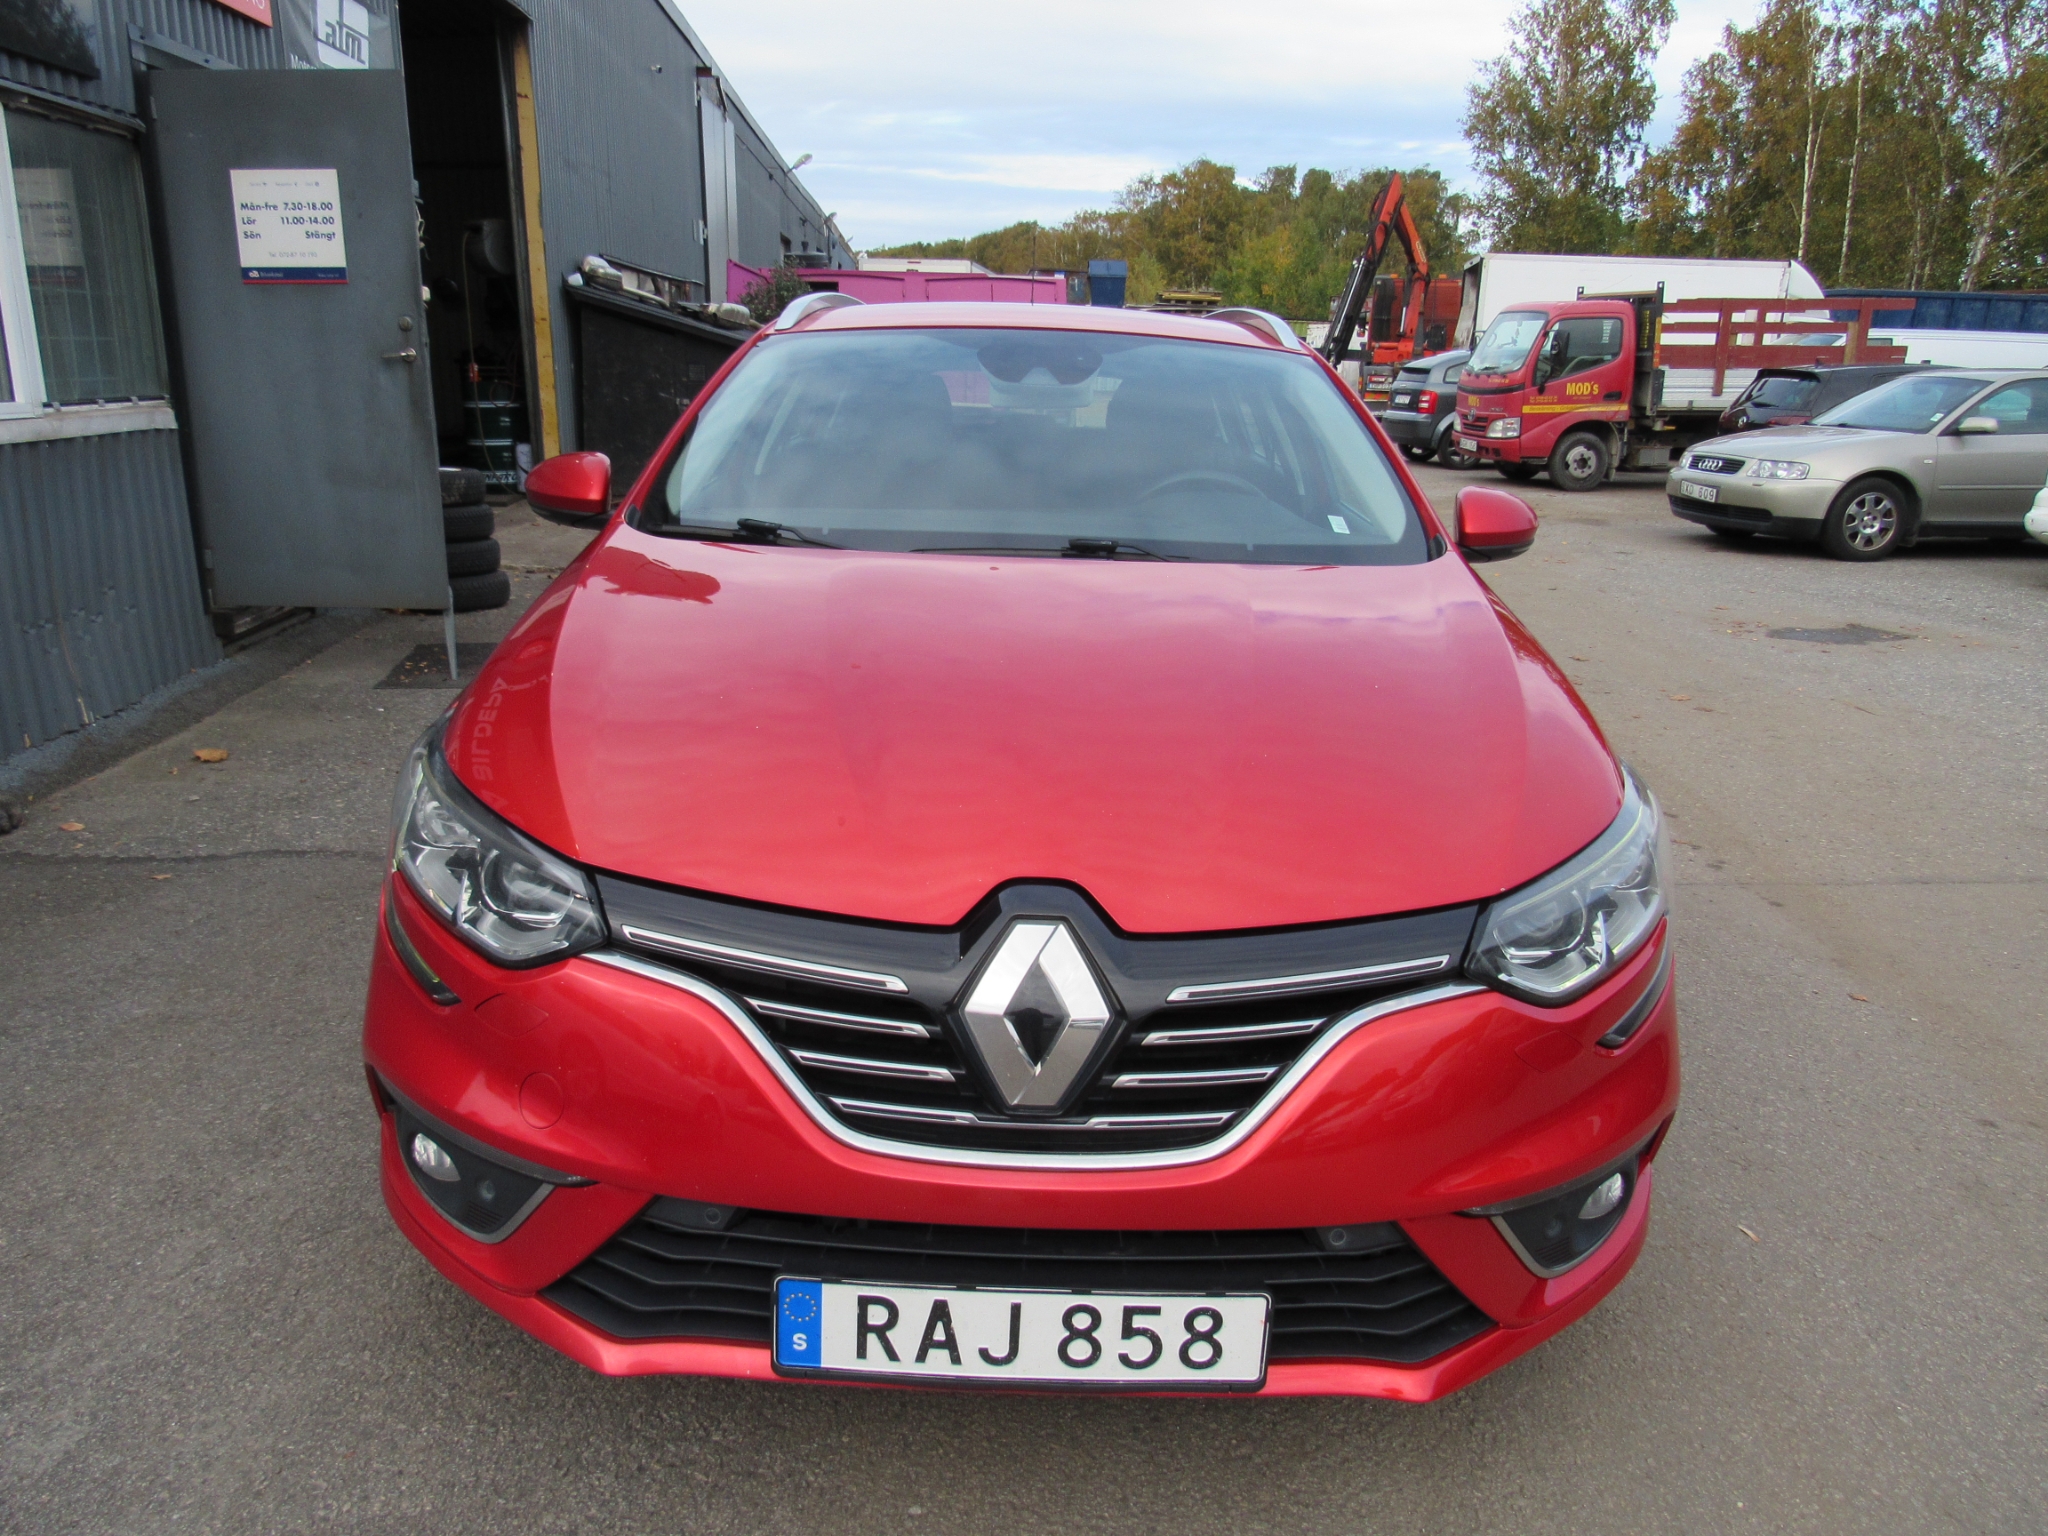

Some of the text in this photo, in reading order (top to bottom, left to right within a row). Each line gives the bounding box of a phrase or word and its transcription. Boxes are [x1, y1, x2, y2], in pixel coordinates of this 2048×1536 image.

[240, 202, 333, 211] Mån-fre 7.30-18.00
[242, 217, 335, 225] Lör 11.00-14.00
[243, 230, 336, 241] Sön Stängt
[1698, 487, 1714, 500] 609
[856, 1294, 1224, 1370] RAJ 858
[792, 1332, 808, 1350] S
